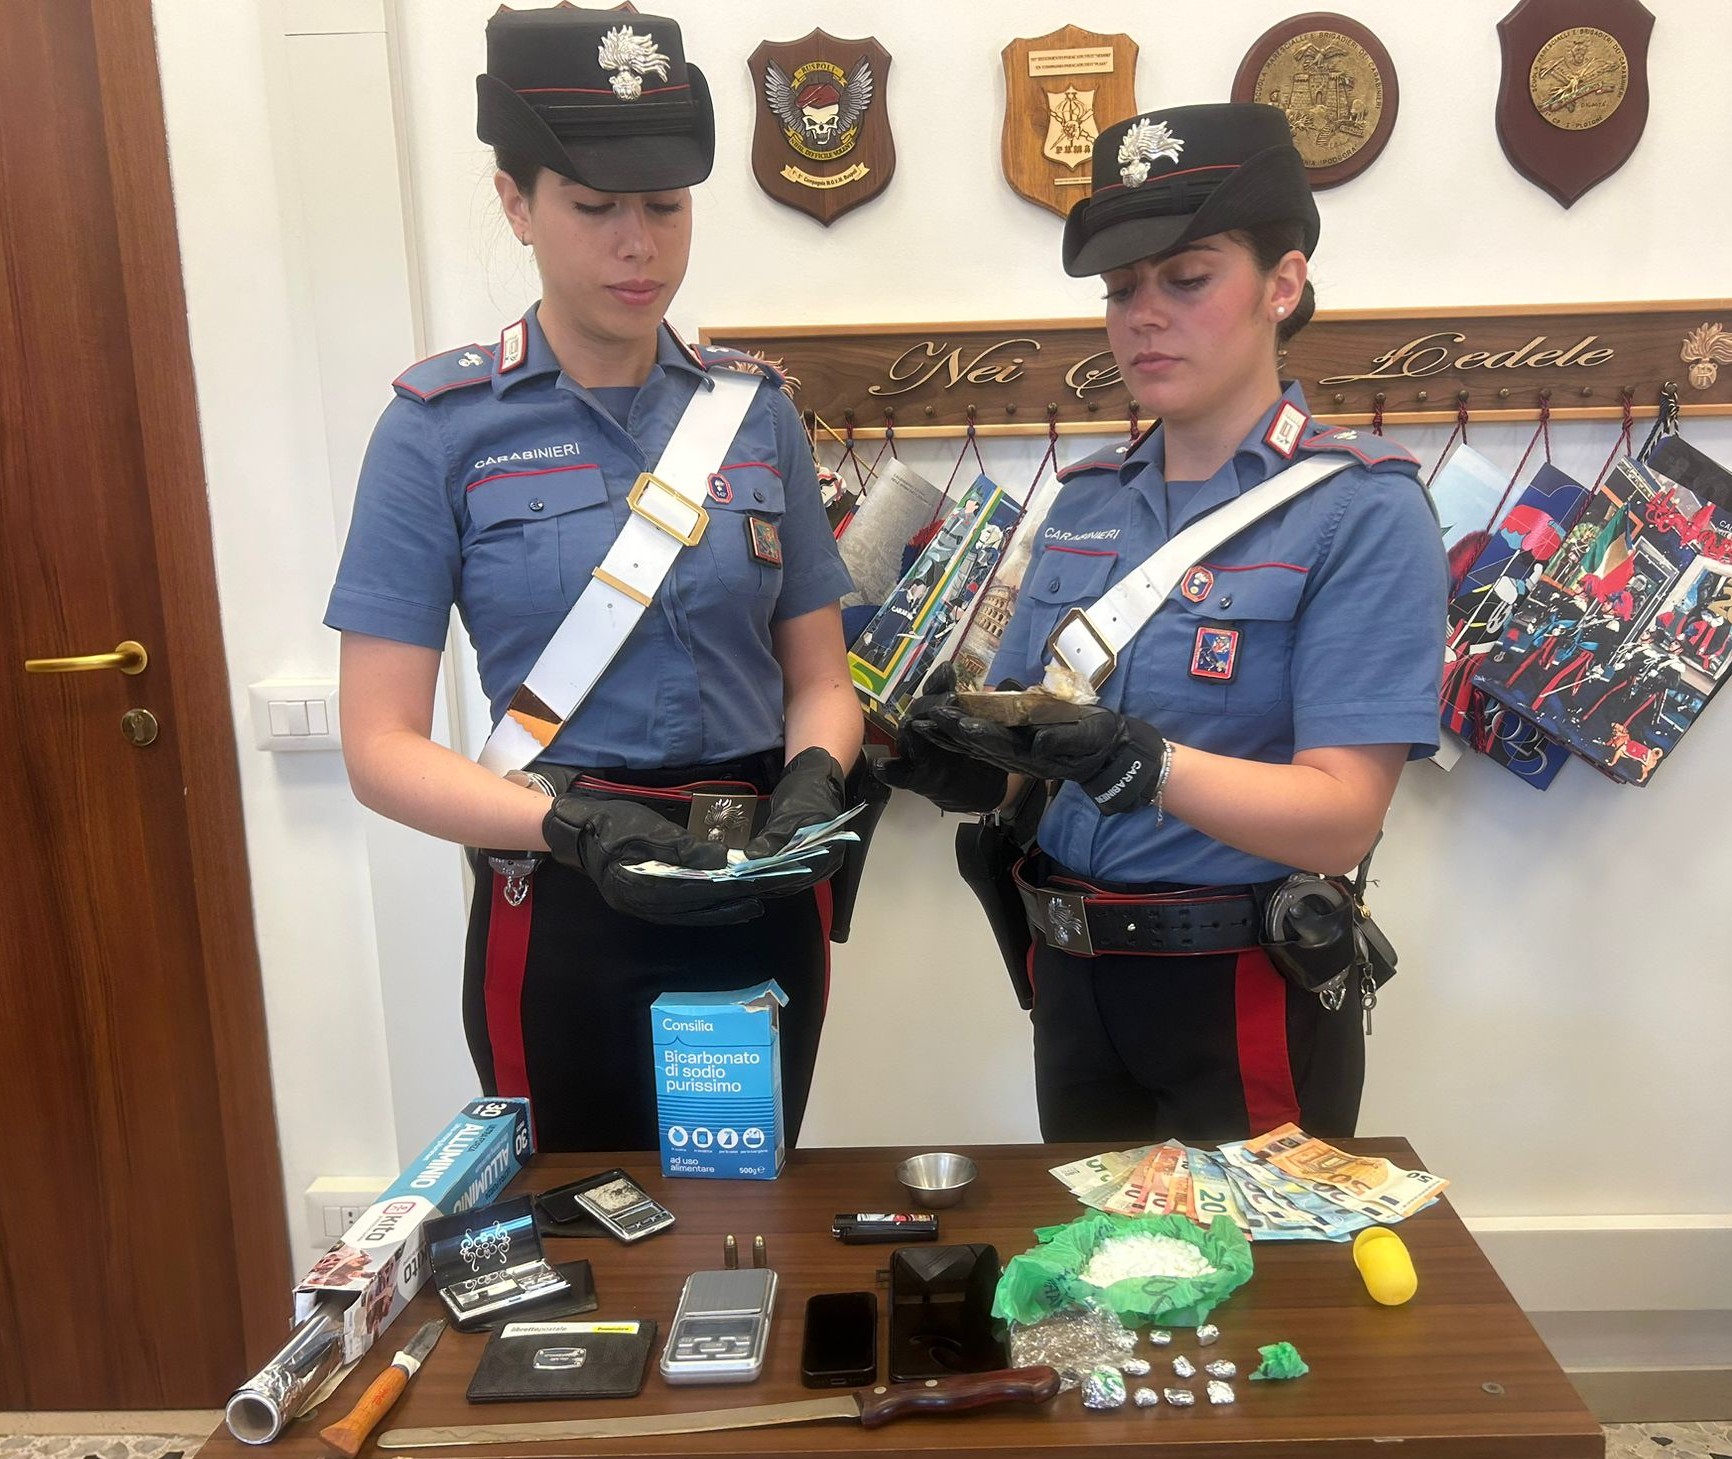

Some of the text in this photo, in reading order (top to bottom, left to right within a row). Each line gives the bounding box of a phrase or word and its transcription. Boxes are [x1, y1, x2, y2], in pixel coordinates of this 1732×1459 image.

[1319, 32, 1358, 49] BRIGADIERI
[801, 63, 835, 74] RUSPOLI
[868, 338, 1041, 396] Nei
[474, 442, 580, 469] CARABINIERI
[1044, 527, 1121, 541] CARABINIERI
[662, 1018, 714, 1032] Consilia
[664, 1050, 760, 1065] Bicarbonato
[665, 1063, 726, 1079] di sodio
[666, 1079, 742, 1093] purissimo
[480, 1102, 508, 1117] 30
[515, 1128, 528, 1156] 30
[409, 1122, 485, 1189] ALLUMINIO
[670, 1164, 715, 1173] alimentare
[1406, 1171, 1434, 1184] 50
[1199, 1188, 1228, 1214] 20
